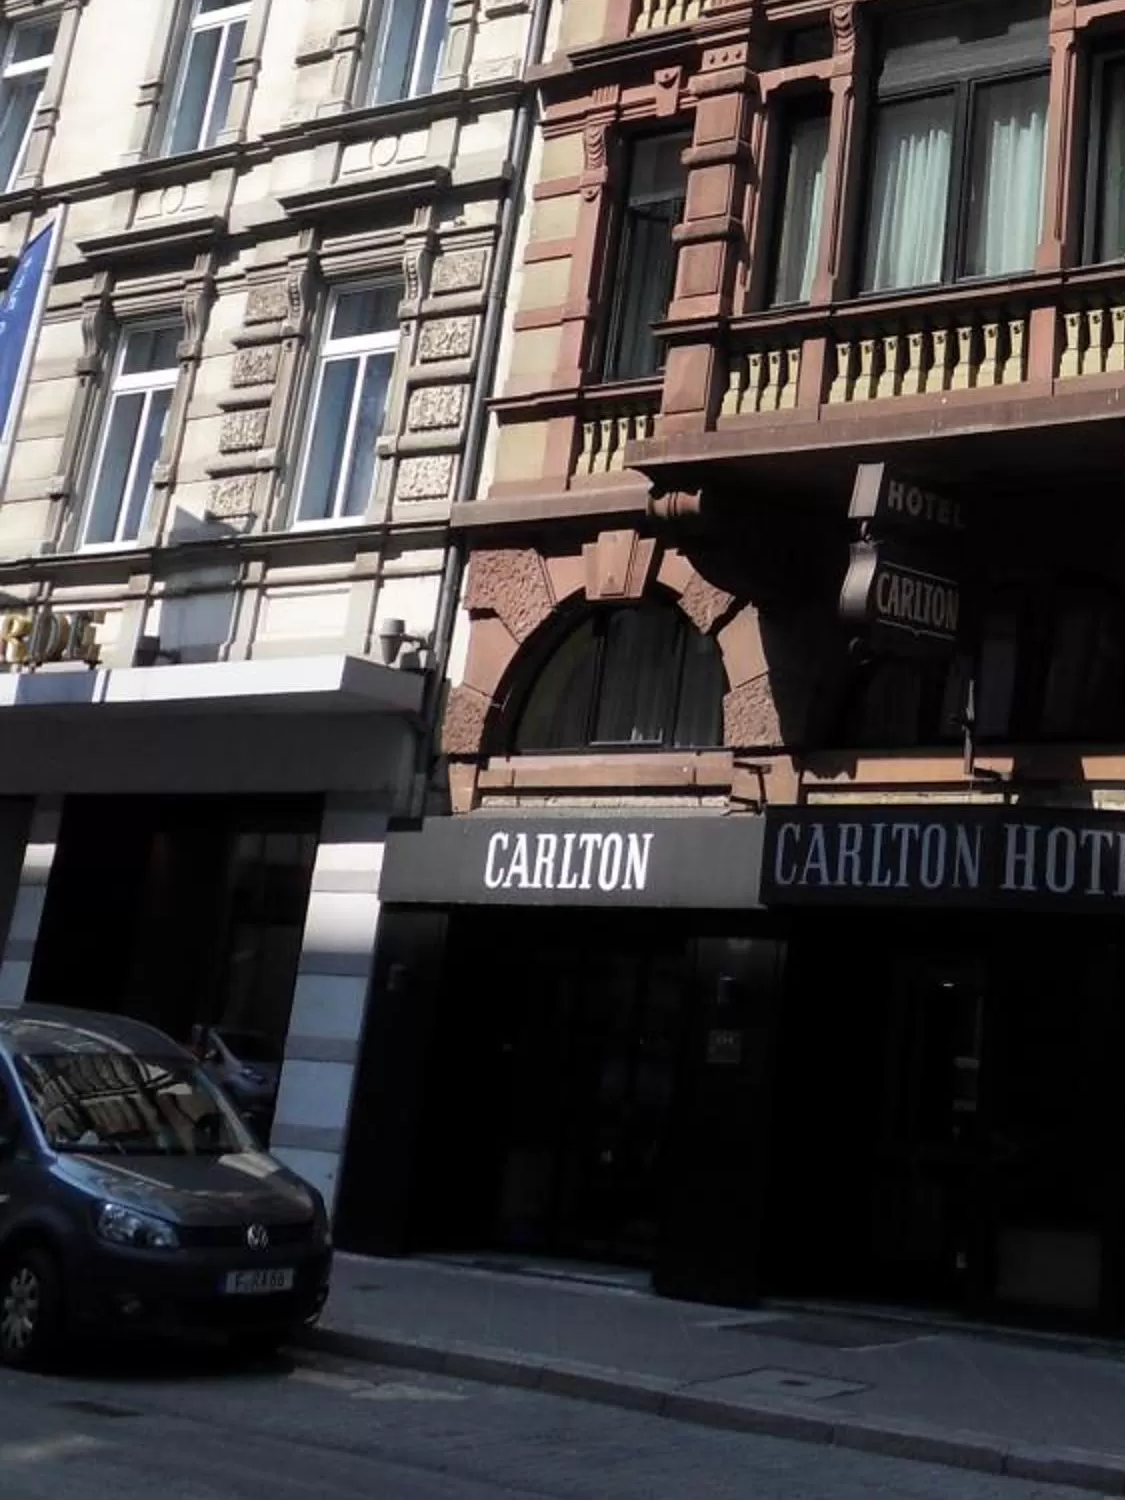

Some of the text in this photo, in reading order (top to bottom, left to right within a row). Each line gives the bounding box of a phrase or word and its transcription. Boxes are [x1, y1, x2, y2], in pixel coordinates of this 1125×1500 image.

[887, 479, 966, 530] HOTEL
[876, 571, 960, 631] CARLTON
[484, 831, 655, 891] CARLTON
[774, 822, 983, 889] CARLTON
